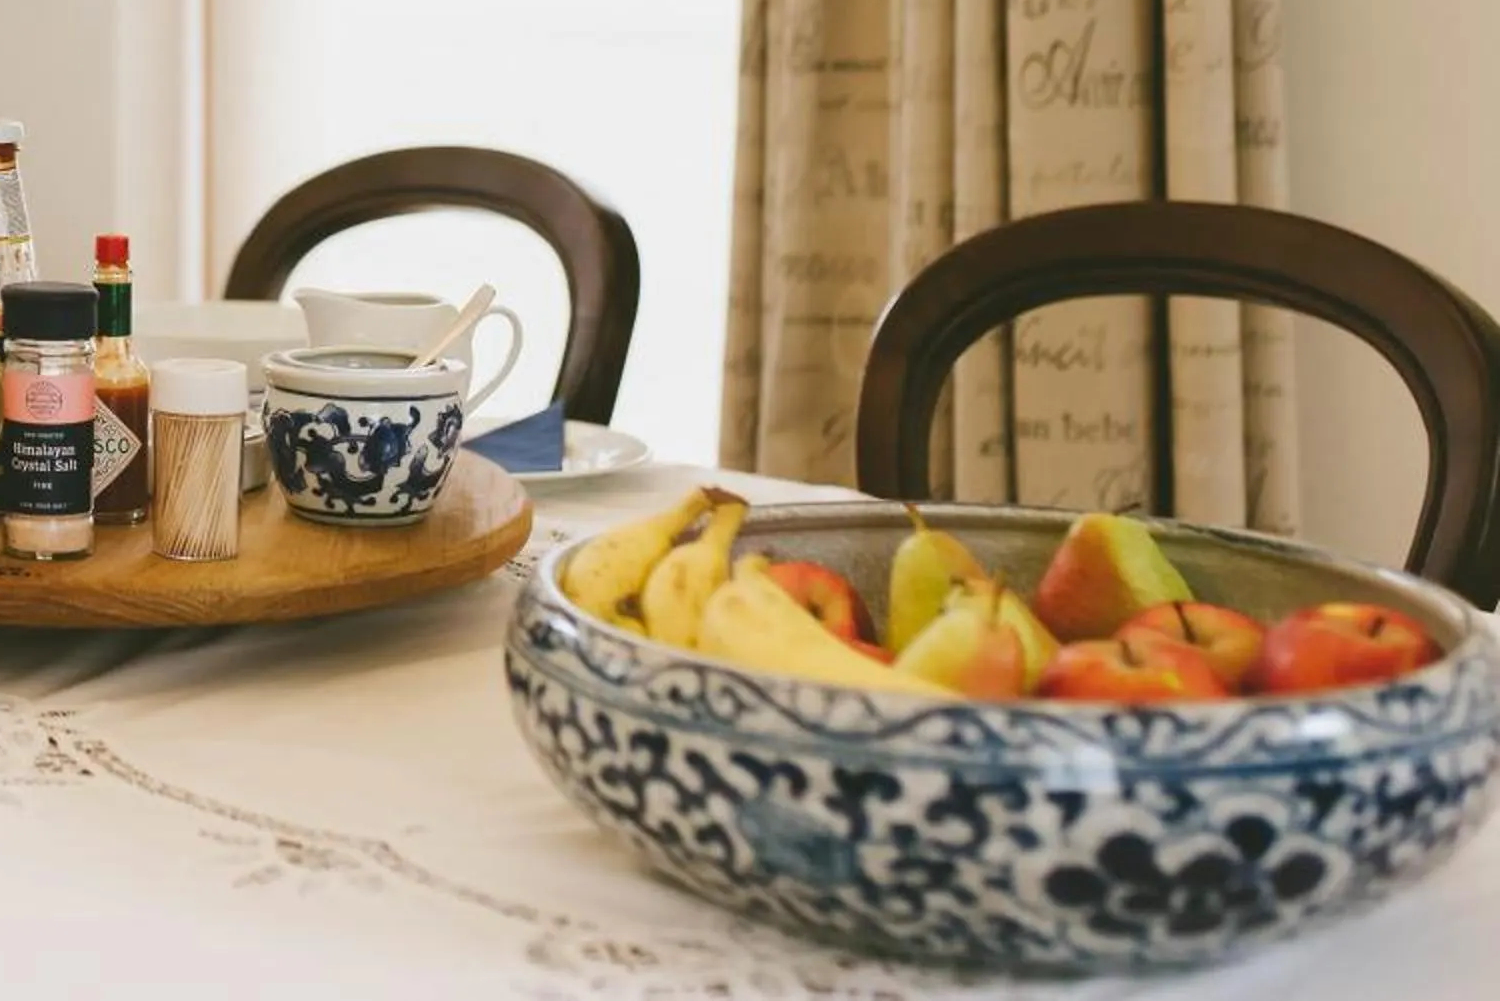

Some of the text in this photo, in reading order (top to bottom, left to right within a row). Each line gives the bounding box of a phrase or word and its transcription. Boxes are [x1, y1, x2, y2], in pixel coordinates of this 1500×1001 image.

[13, 441, 76, 458] Himalayan
[11, 456, 78, 472] Crystal Salt
